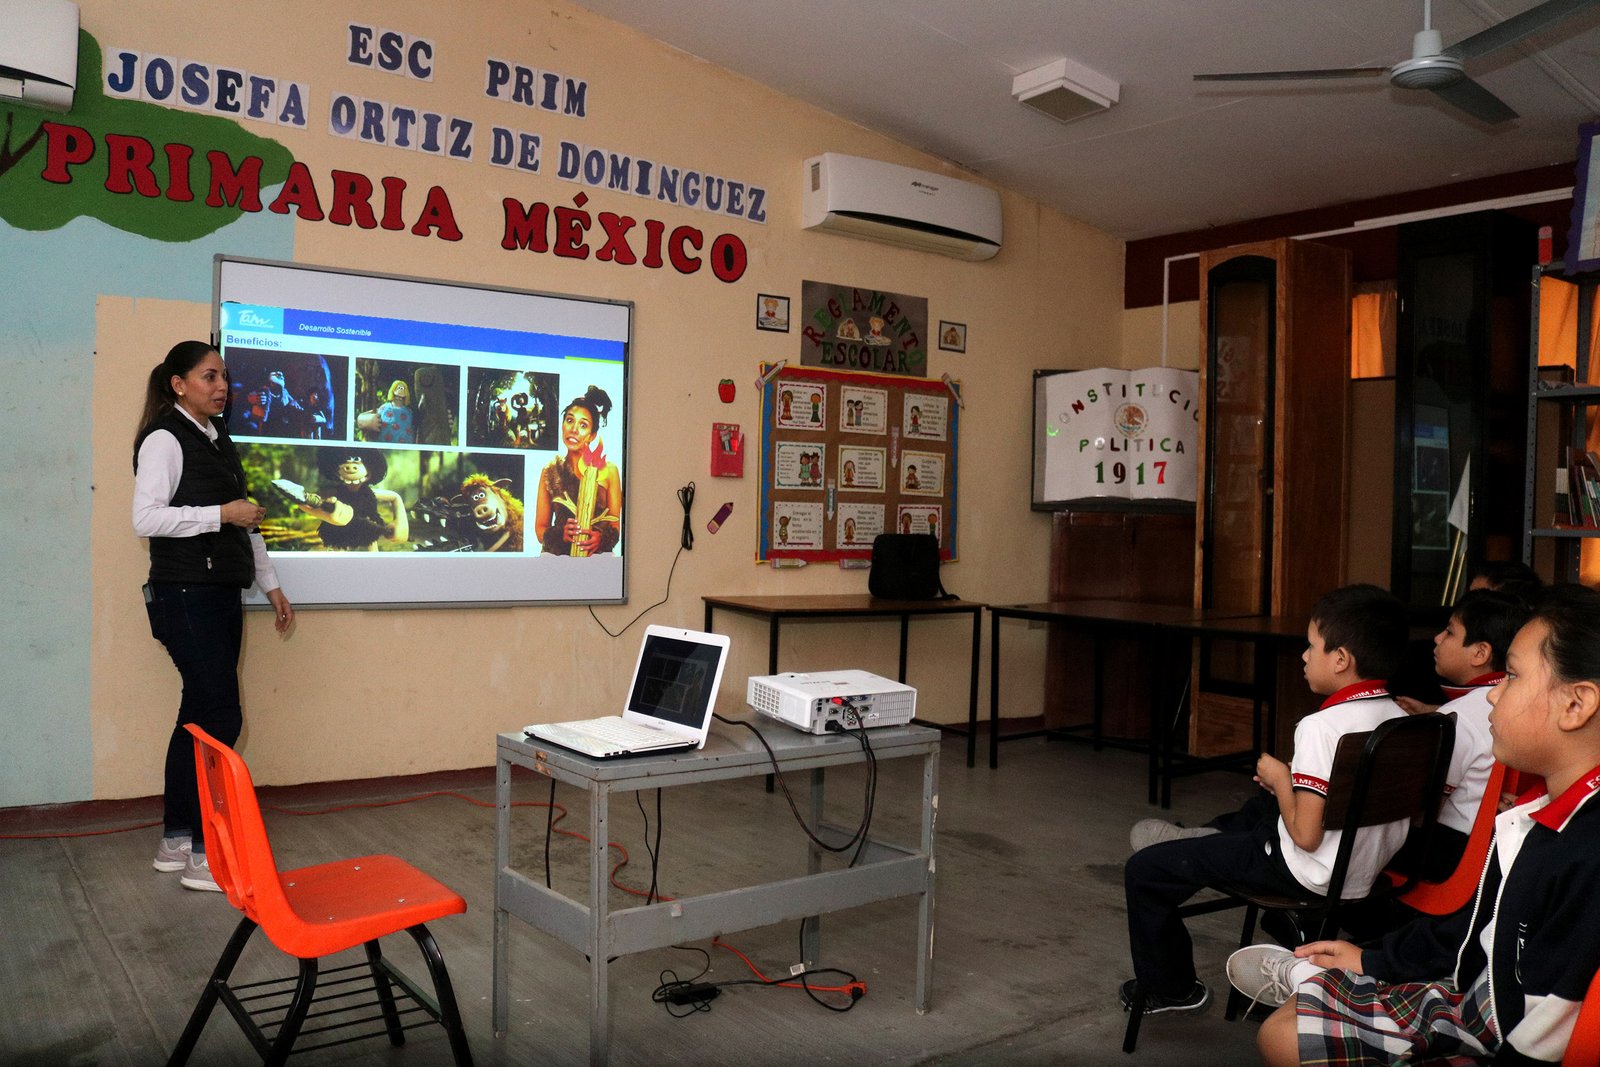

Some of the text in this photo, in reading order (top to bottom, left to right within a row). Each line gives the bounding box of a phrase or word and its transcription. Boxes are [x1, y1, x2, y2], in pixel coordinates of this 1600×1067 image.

[348, 24, 588, 118] ESC PRIM
[108, 52, 766, 222] JOSEFA ORTIZ DE DOMINGUEZ
[40, 121, 748, 283] PRIMARIA MÉXICO
[226, 334, 282, 347] Beneficios:
[299, 323, 372, 337] Desarrollo Sostenible
[802, 288, 924, 366] REGLAMENTO
[820, 341, 911, 372] ESCOLAR
[1080, 437, 1185, 454] POLITICA
[1094, 461, 1167, 485] 1917
